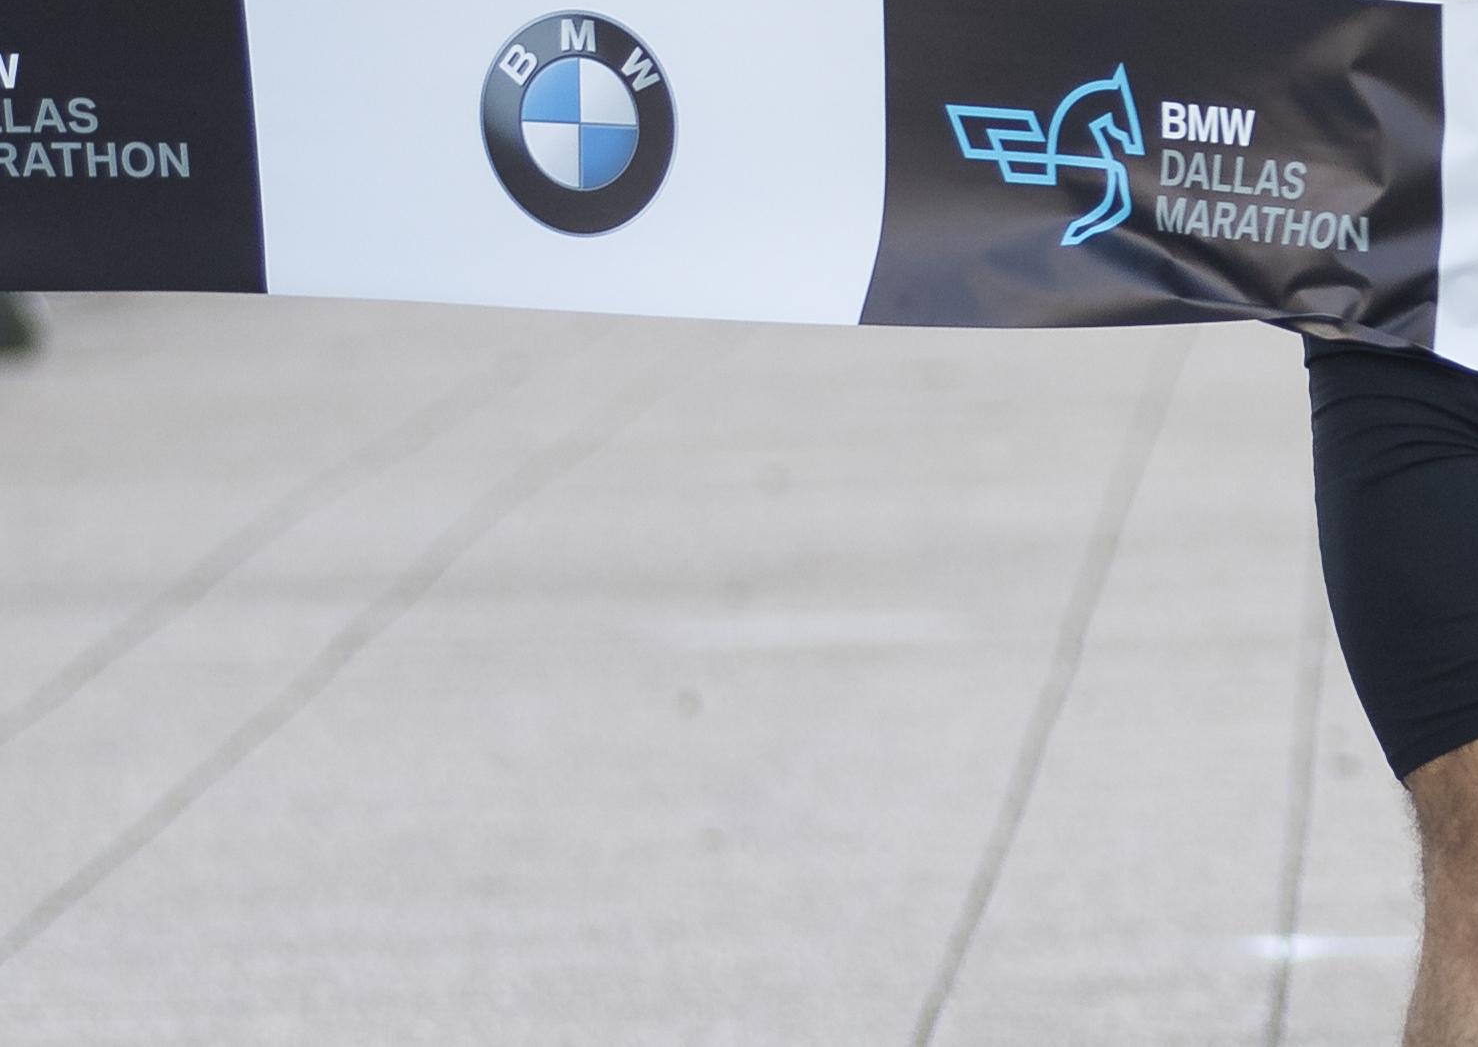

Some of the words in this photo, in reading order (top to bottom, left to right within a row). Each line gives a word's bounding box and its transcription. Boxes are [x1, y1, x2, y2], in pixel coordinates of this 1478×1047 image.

[499, 18, 661, 92] BMW
[0, 97, 99, 134] LAS
[1161, 101, 1255, 146] BMW
[1159, 149, 1307, 200] DALLAS
[1155, 195, 1369, 252] MARATHON
